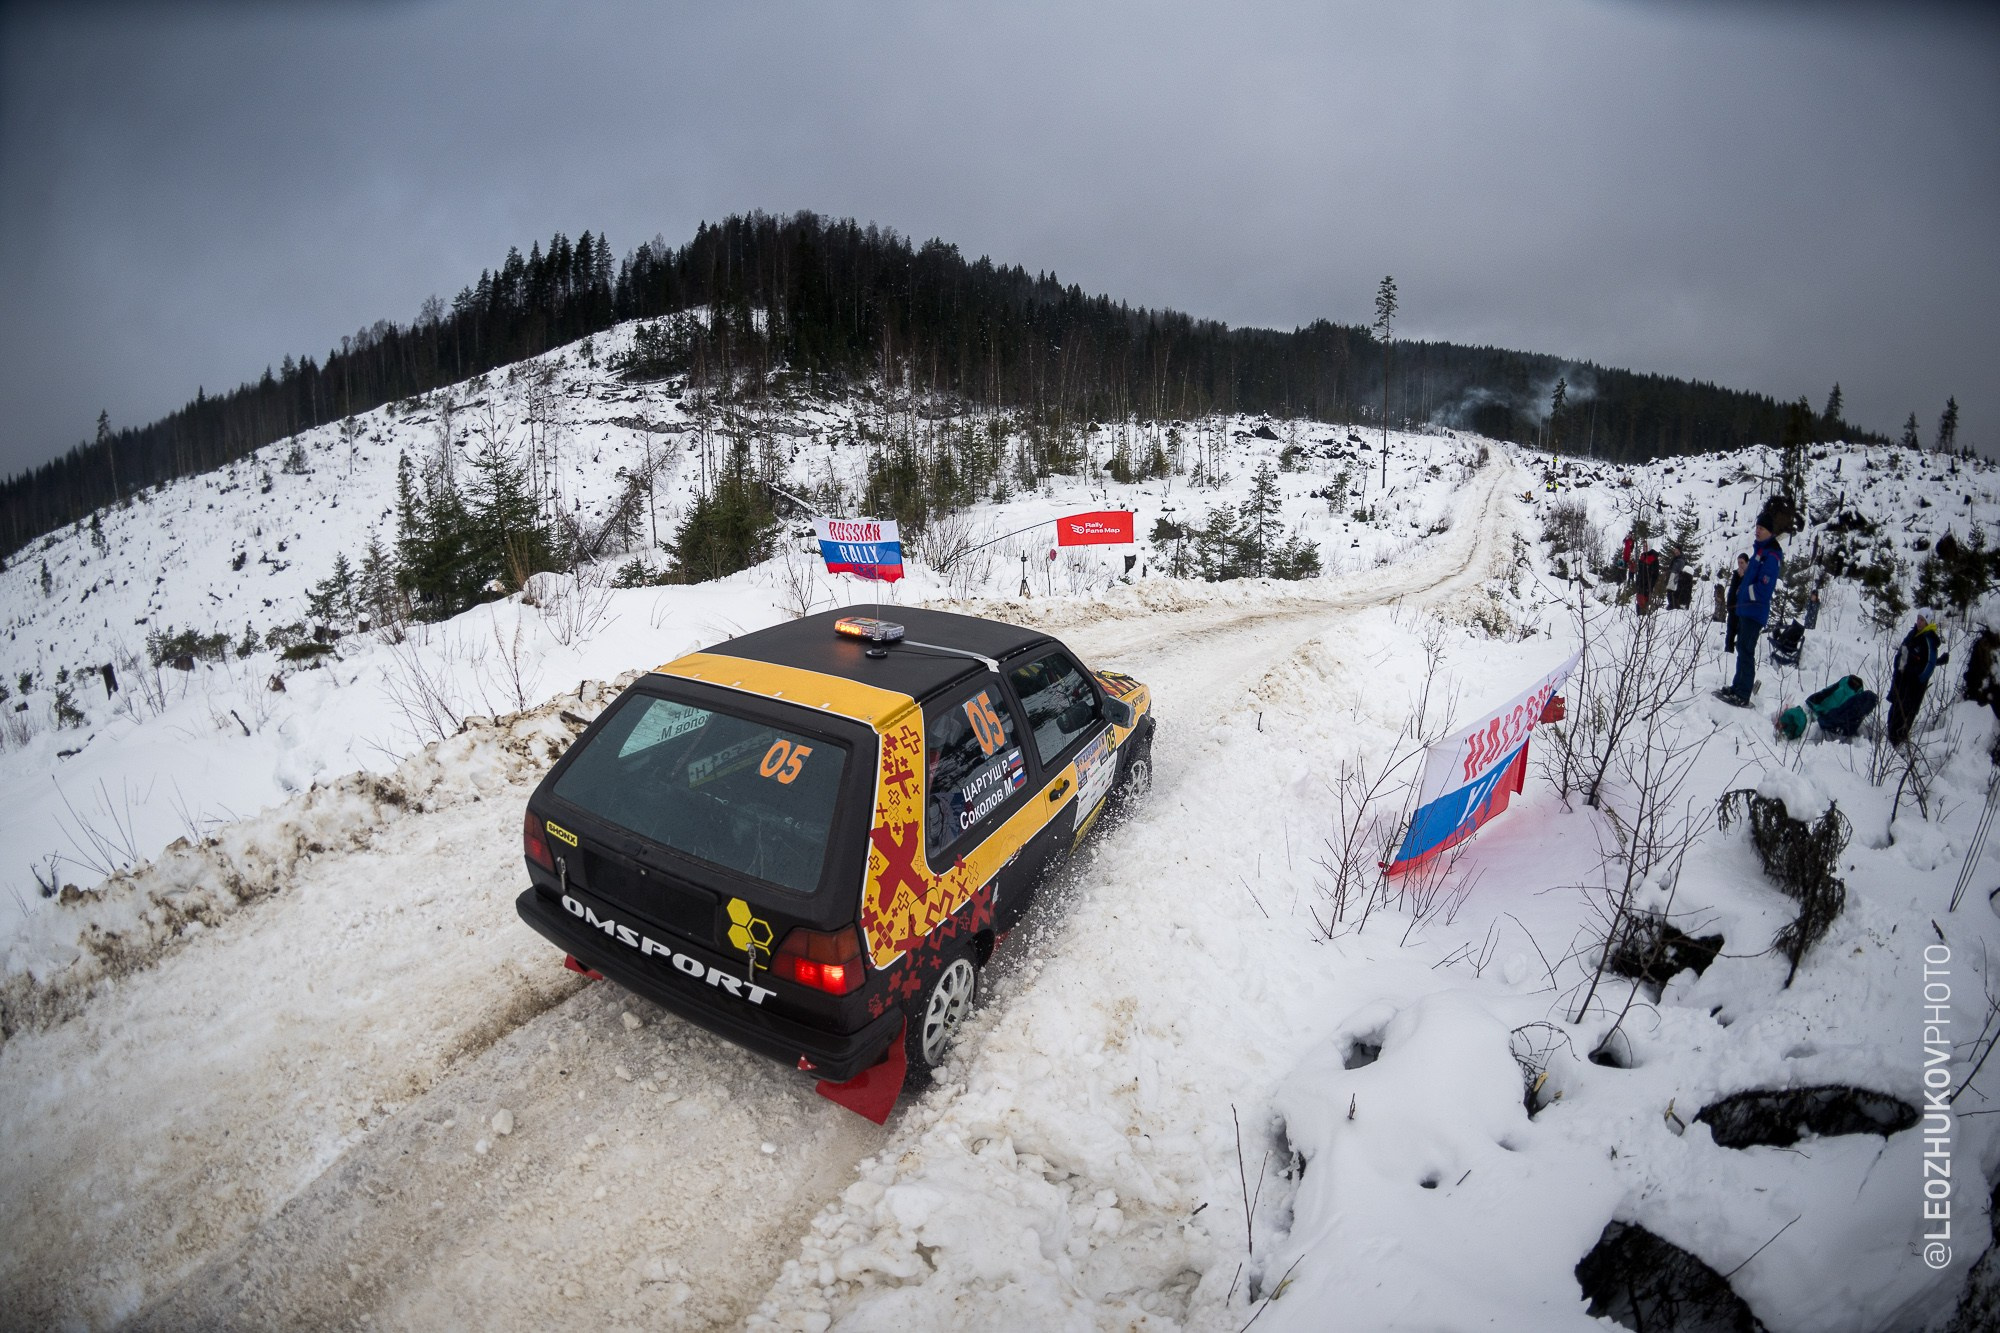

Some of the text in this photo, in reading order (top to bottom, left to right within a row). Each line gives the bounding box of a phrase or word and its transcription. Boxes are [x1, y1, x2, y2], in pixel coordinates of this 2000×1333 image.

[828, 521, 881, 542] RUSSIAN
[838, 544, 880, 564] RALLY
[966, 691, 1005, 756] 05
[1106, 730, 1116, 752] 05
[759, 739, 813, 785] 05
[962, 759, 1011, 803] ЦАРГУШ Р.
[1004, 776, 1016, 796] М.
[548, 823, 576, 845] SHONX
[561, 894, 777, 1005] OMSPORT
